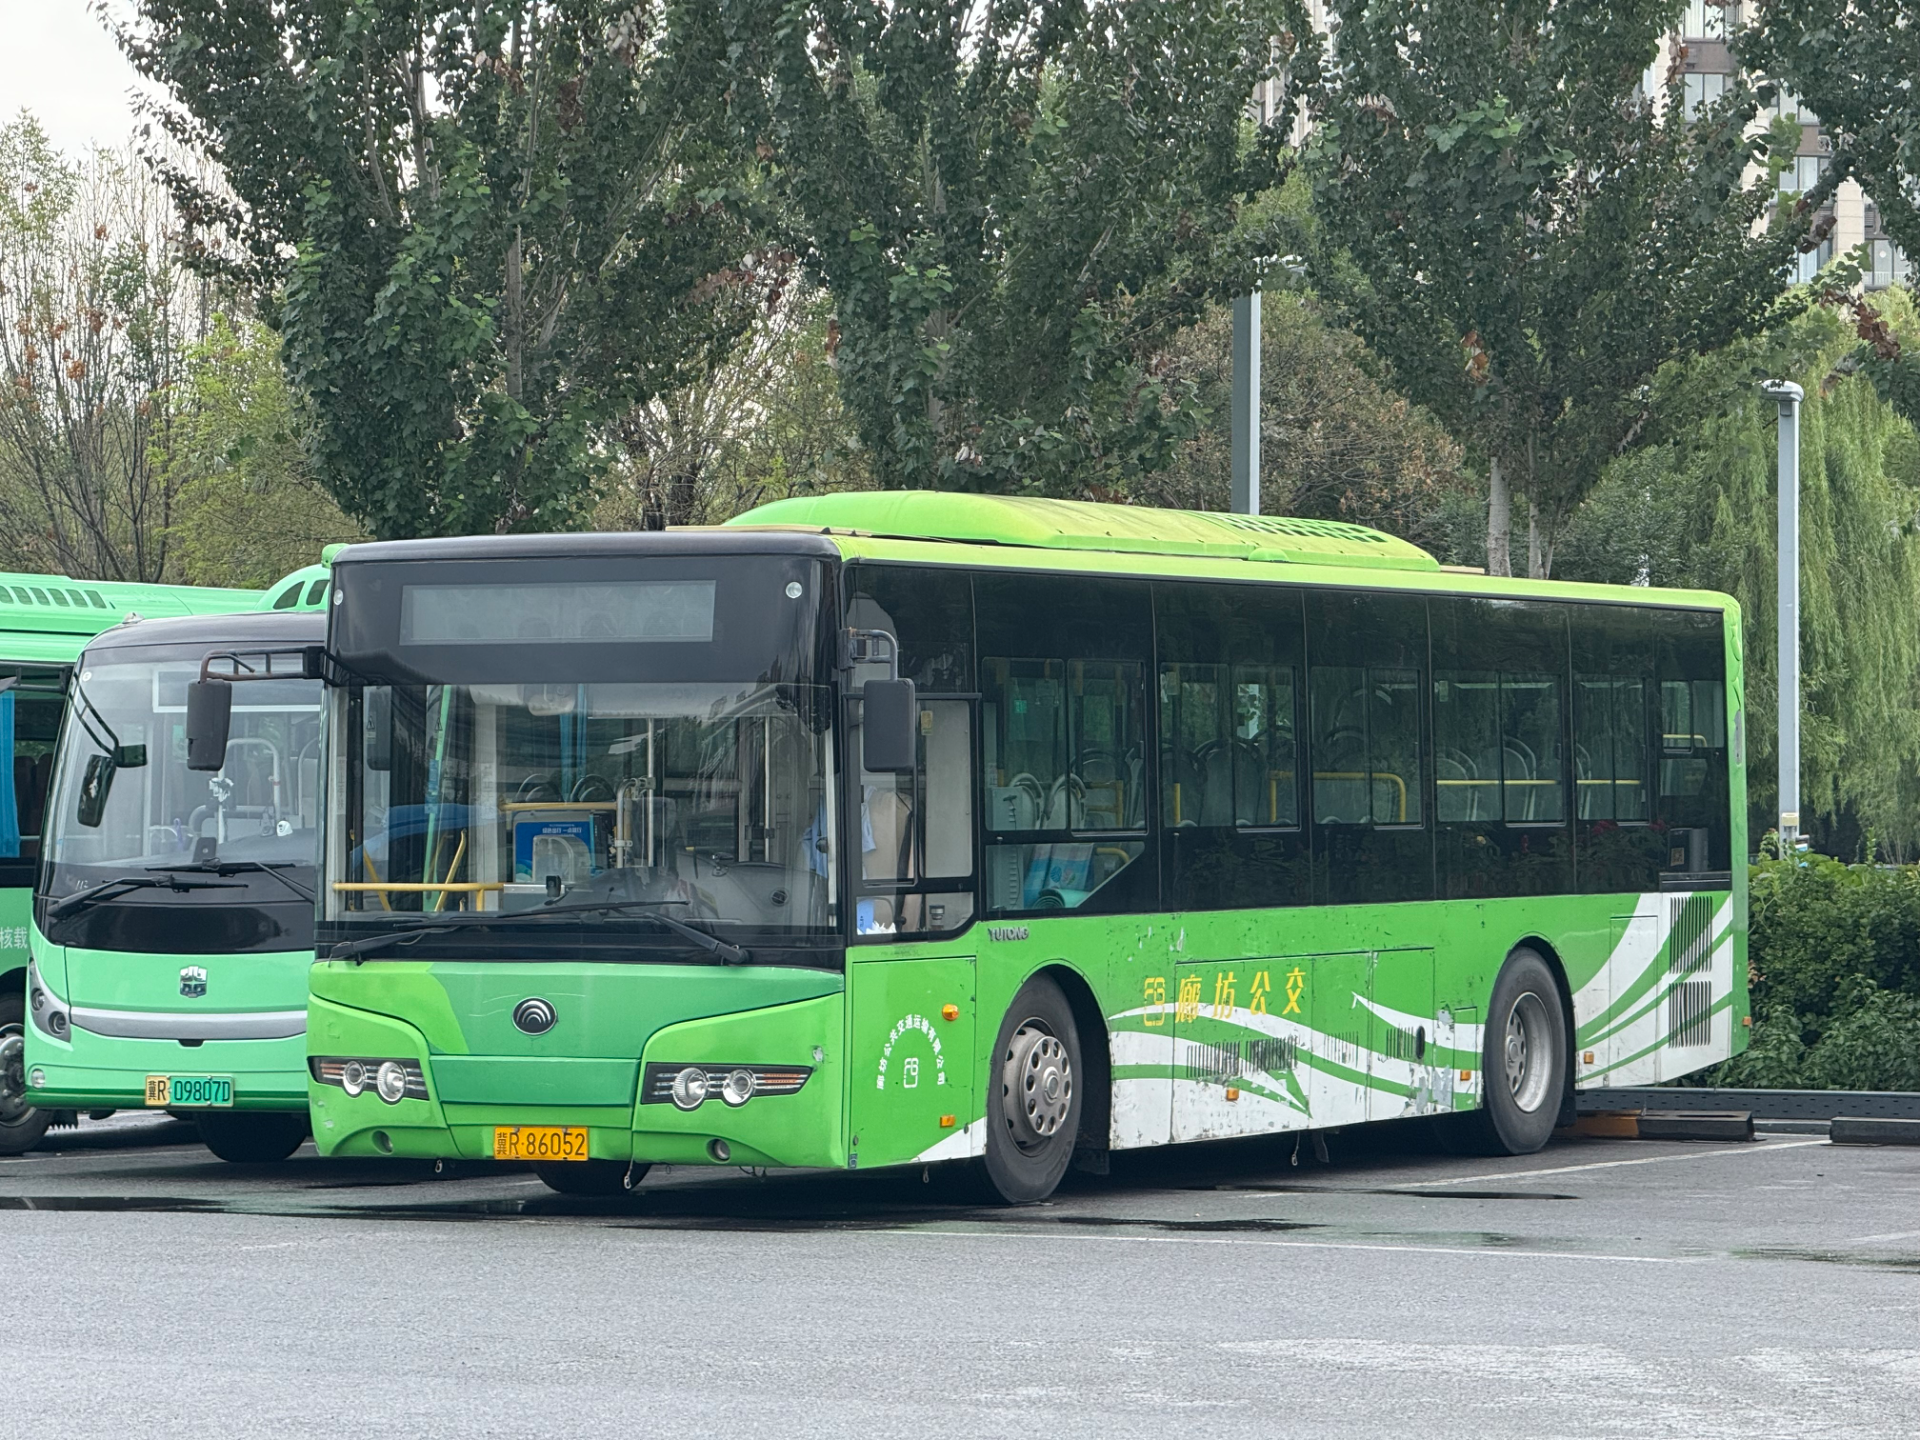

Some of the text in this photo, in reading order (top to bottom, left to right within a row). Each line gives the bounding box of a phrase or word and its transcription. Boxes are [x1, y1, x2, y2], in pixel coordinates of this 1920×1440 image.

[0, 926, 28, 949] 核载
[988, 927, 1029, 941] YUTONG
[1175, 967, 1306, 1024] 廊坊公交
